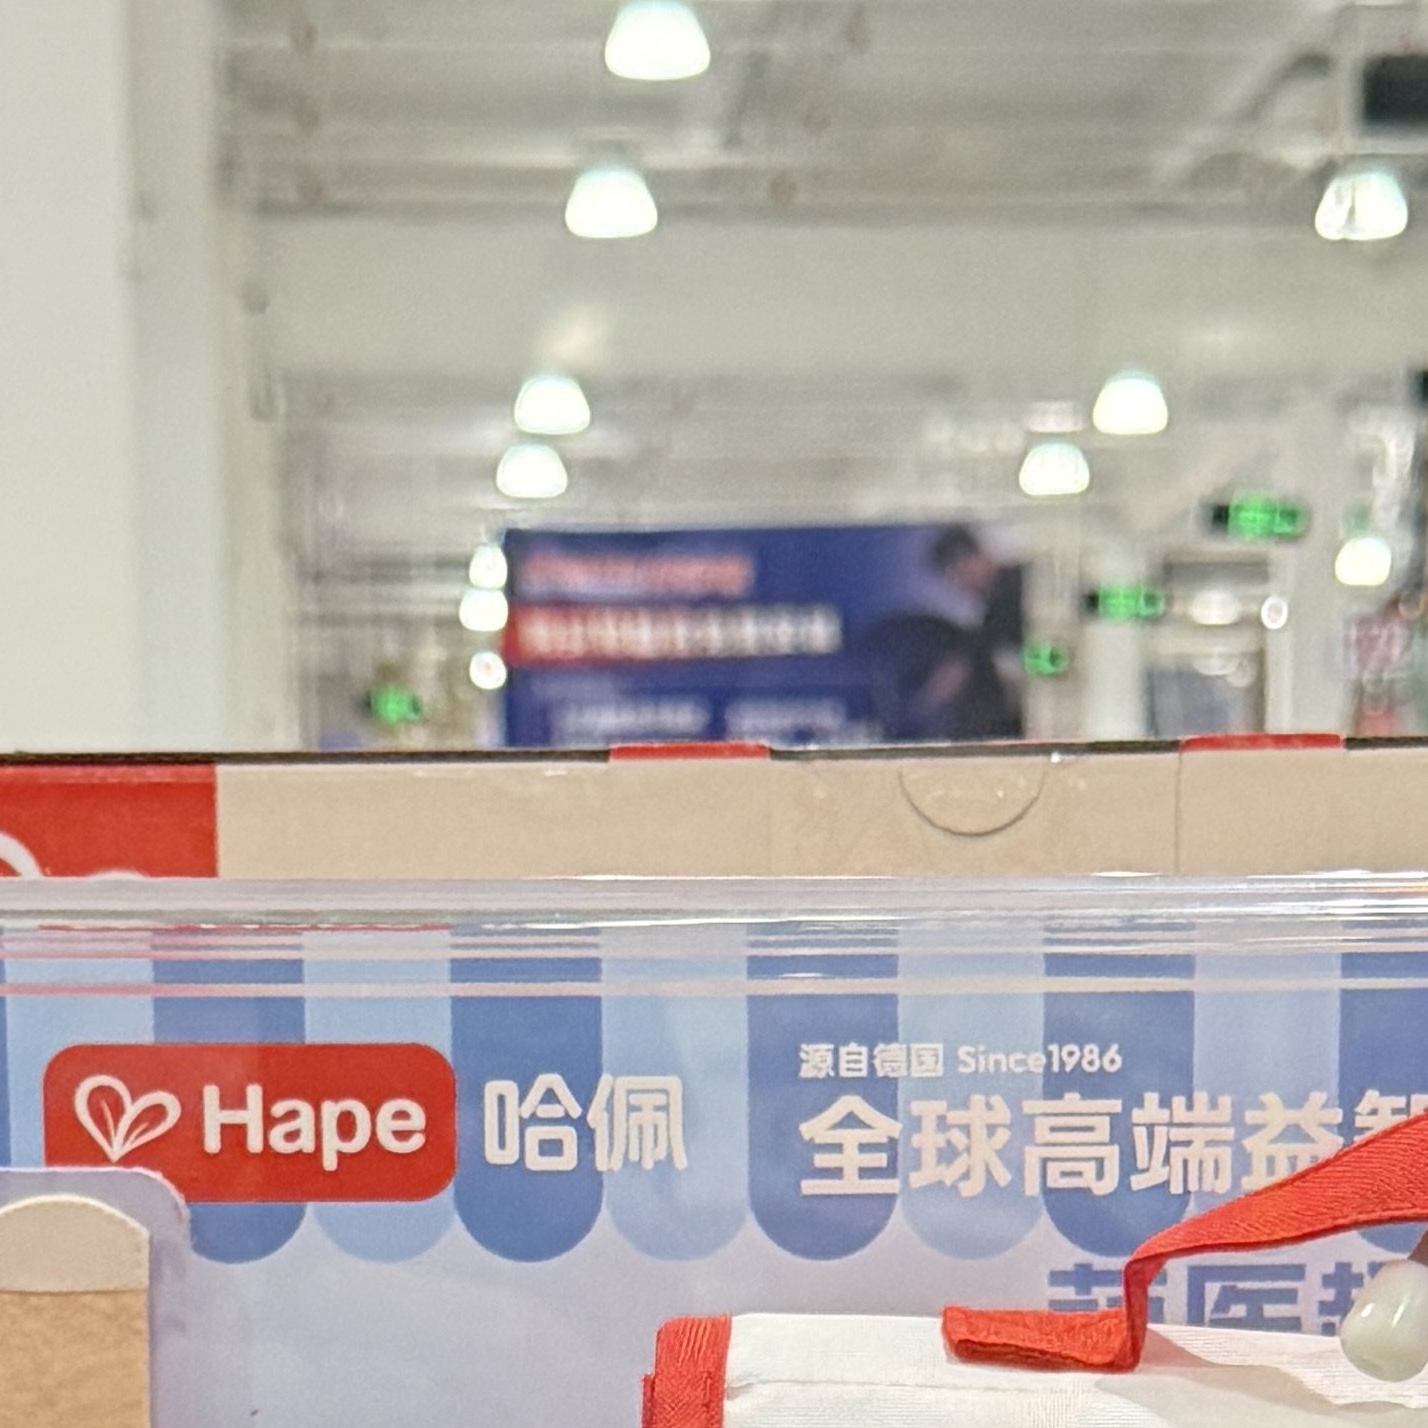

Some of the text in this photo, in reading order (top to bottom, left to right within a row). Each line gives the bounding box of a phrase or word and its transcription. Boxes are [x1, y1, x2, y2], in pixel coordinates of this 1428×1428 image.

[798, 1042, 1123, 1078] 源自德国 Since1986
[202, 1083, 426, 1171] Hape
[483, 1073, 687, 1172] 哈佩
